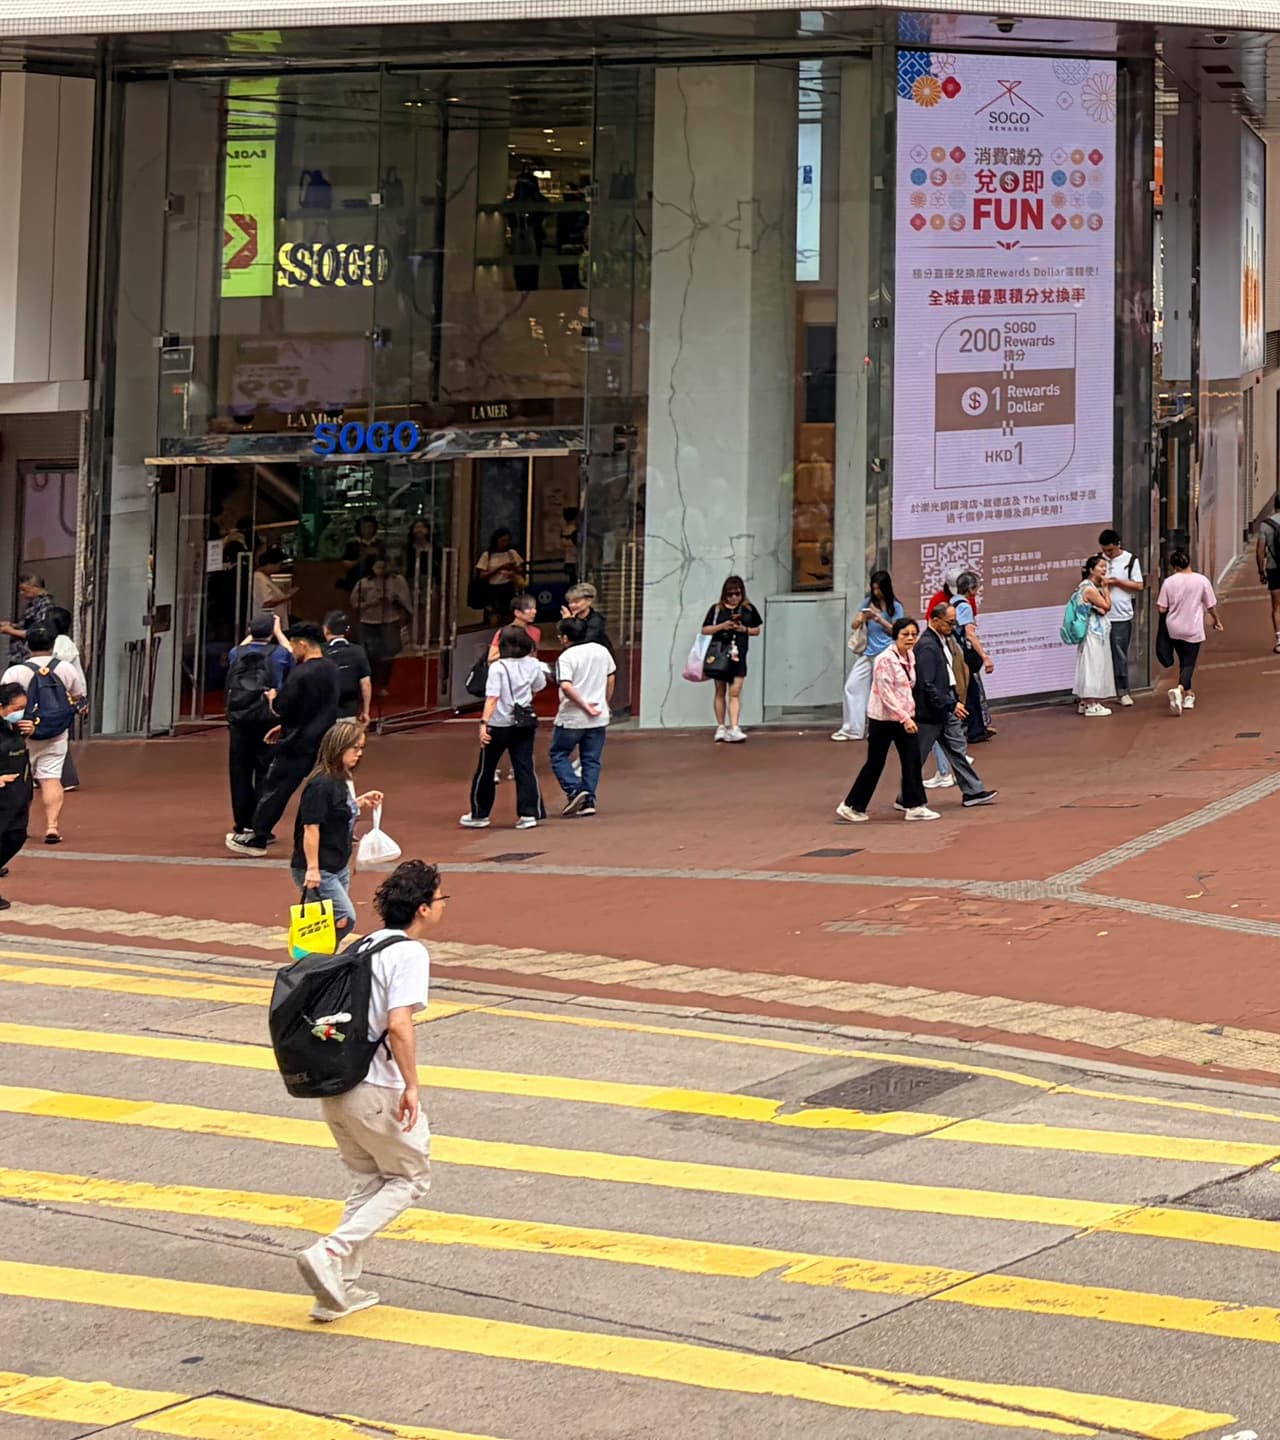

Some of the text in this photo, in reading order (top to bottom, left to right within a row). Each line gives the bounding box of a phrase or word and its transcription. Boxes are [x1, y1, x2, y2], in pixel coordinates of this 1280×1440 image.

[988, 111, 1031, 125] SOGO
[973, 147, 1044, 167] 消費賺分
[972, 197, 1044, 231] FUN
[928, 287, 1086, 307] 全城最優惠積分兌換率
[1004, 321, 1037, 333] SOGO
[959, 328, 1001, 353] 200
[1004, 335, 1055, 347] Rewards
[1004, 350, 1026, 361] 積分
[991, 386, 1001, 411] 1
[1007, 384, 1061, 398] Rewards
[472, 404, 508, 421] LA MER
[1007, 399, 1045, 413] Dollar
[312, 420, 421, 456] SOGO
[985, 440, 1024, 465] HKD 1
[1023, 494, 1041, 504] The
[991, 565, 1013, 576] SOGO
